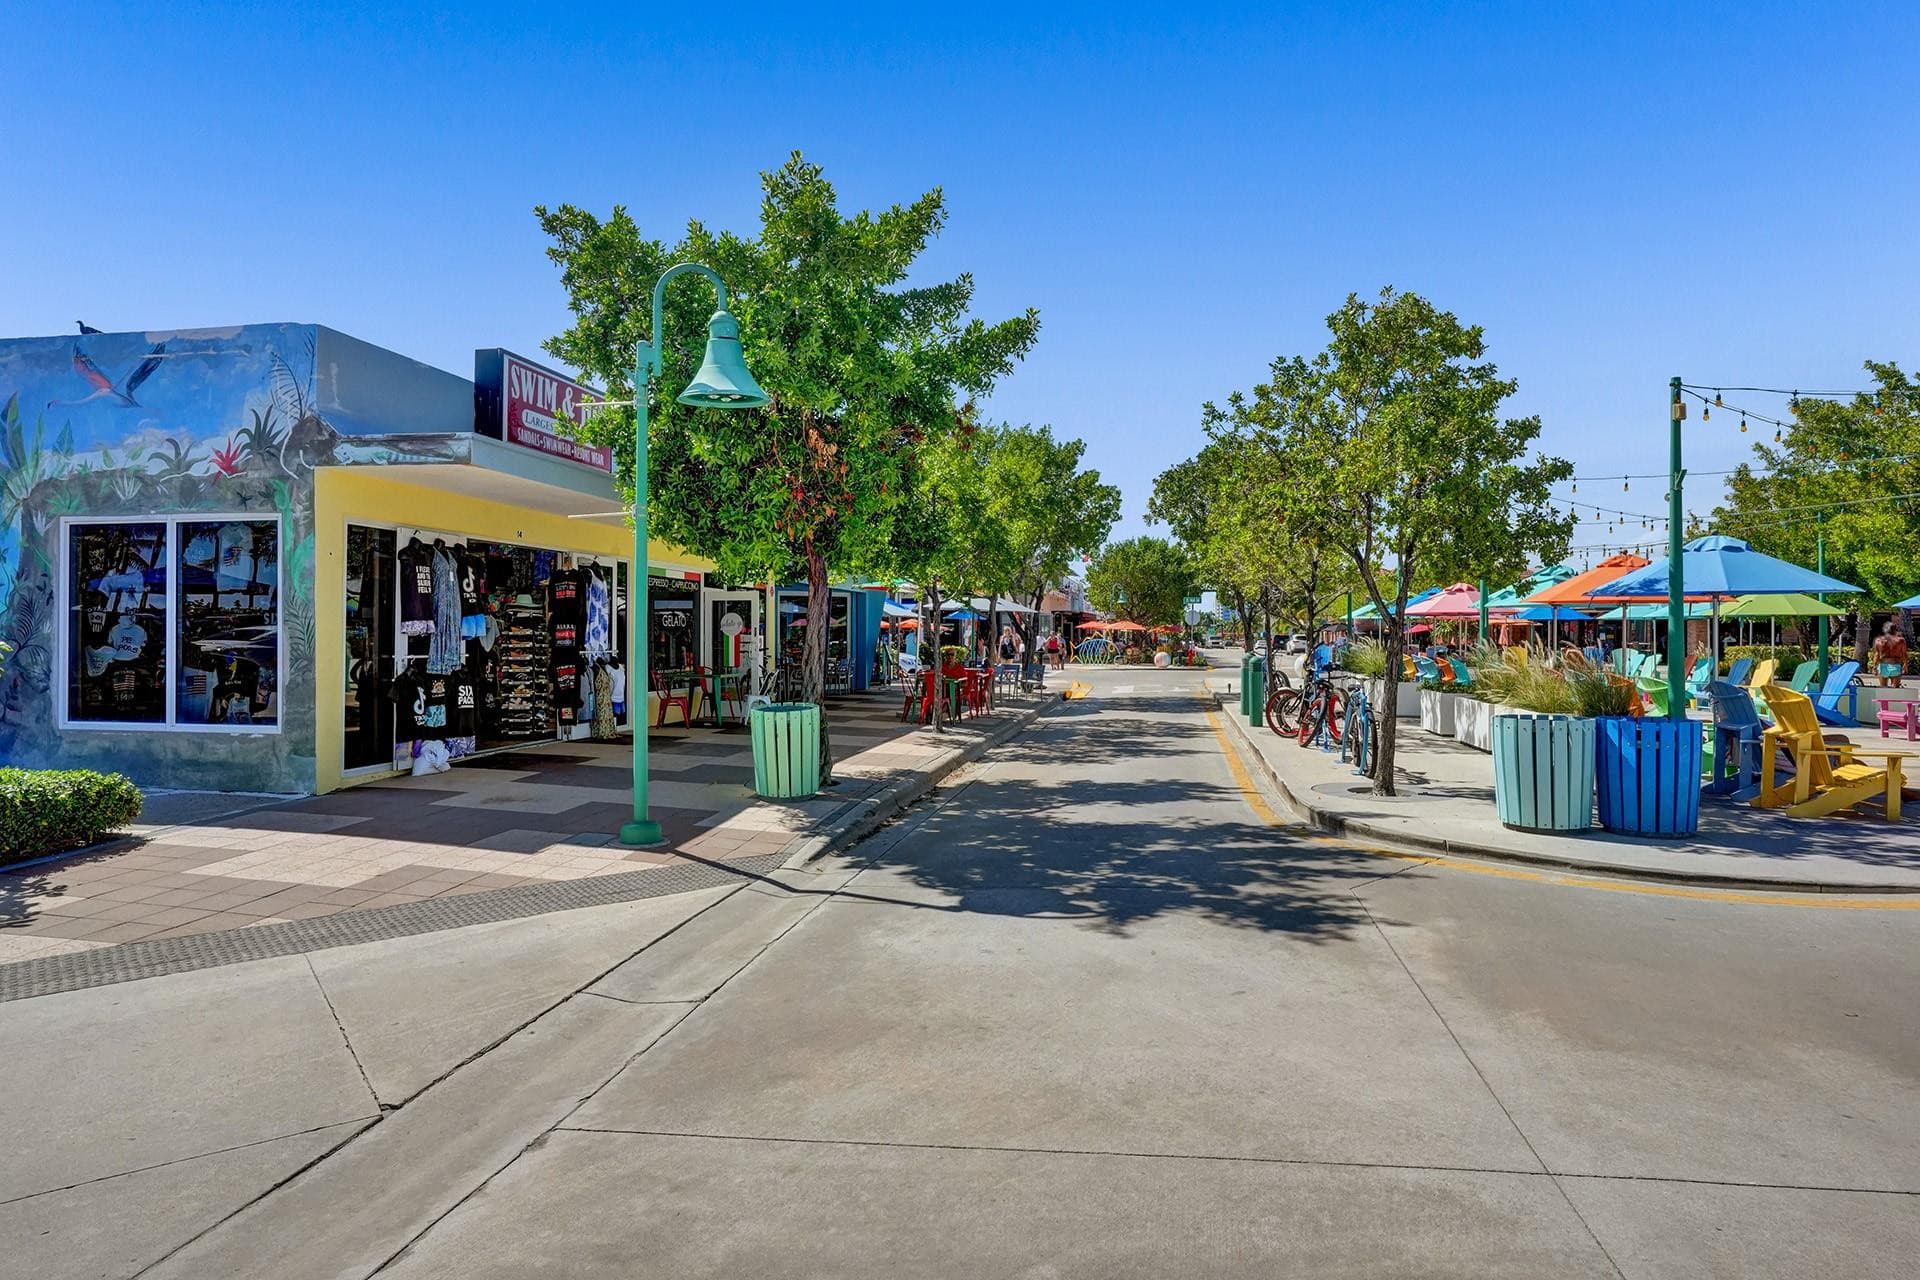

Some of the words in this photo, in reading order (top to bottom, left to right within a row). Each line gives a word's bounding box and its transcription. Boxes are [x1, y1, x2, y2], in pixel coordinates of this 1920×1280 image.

[511, 364, 558, 413] SWIM
[562, 387, 576, 419] &
[525, 412, 554, 431] LARGES
[517, 427, 540, 447] SANDALS
[543, 436, 572, 456] SWIMWEAR
[662, 614, 687, 627] GELATO
[458, 685, 474, 697] SIX
[457, 696, 475, 705] PACK
